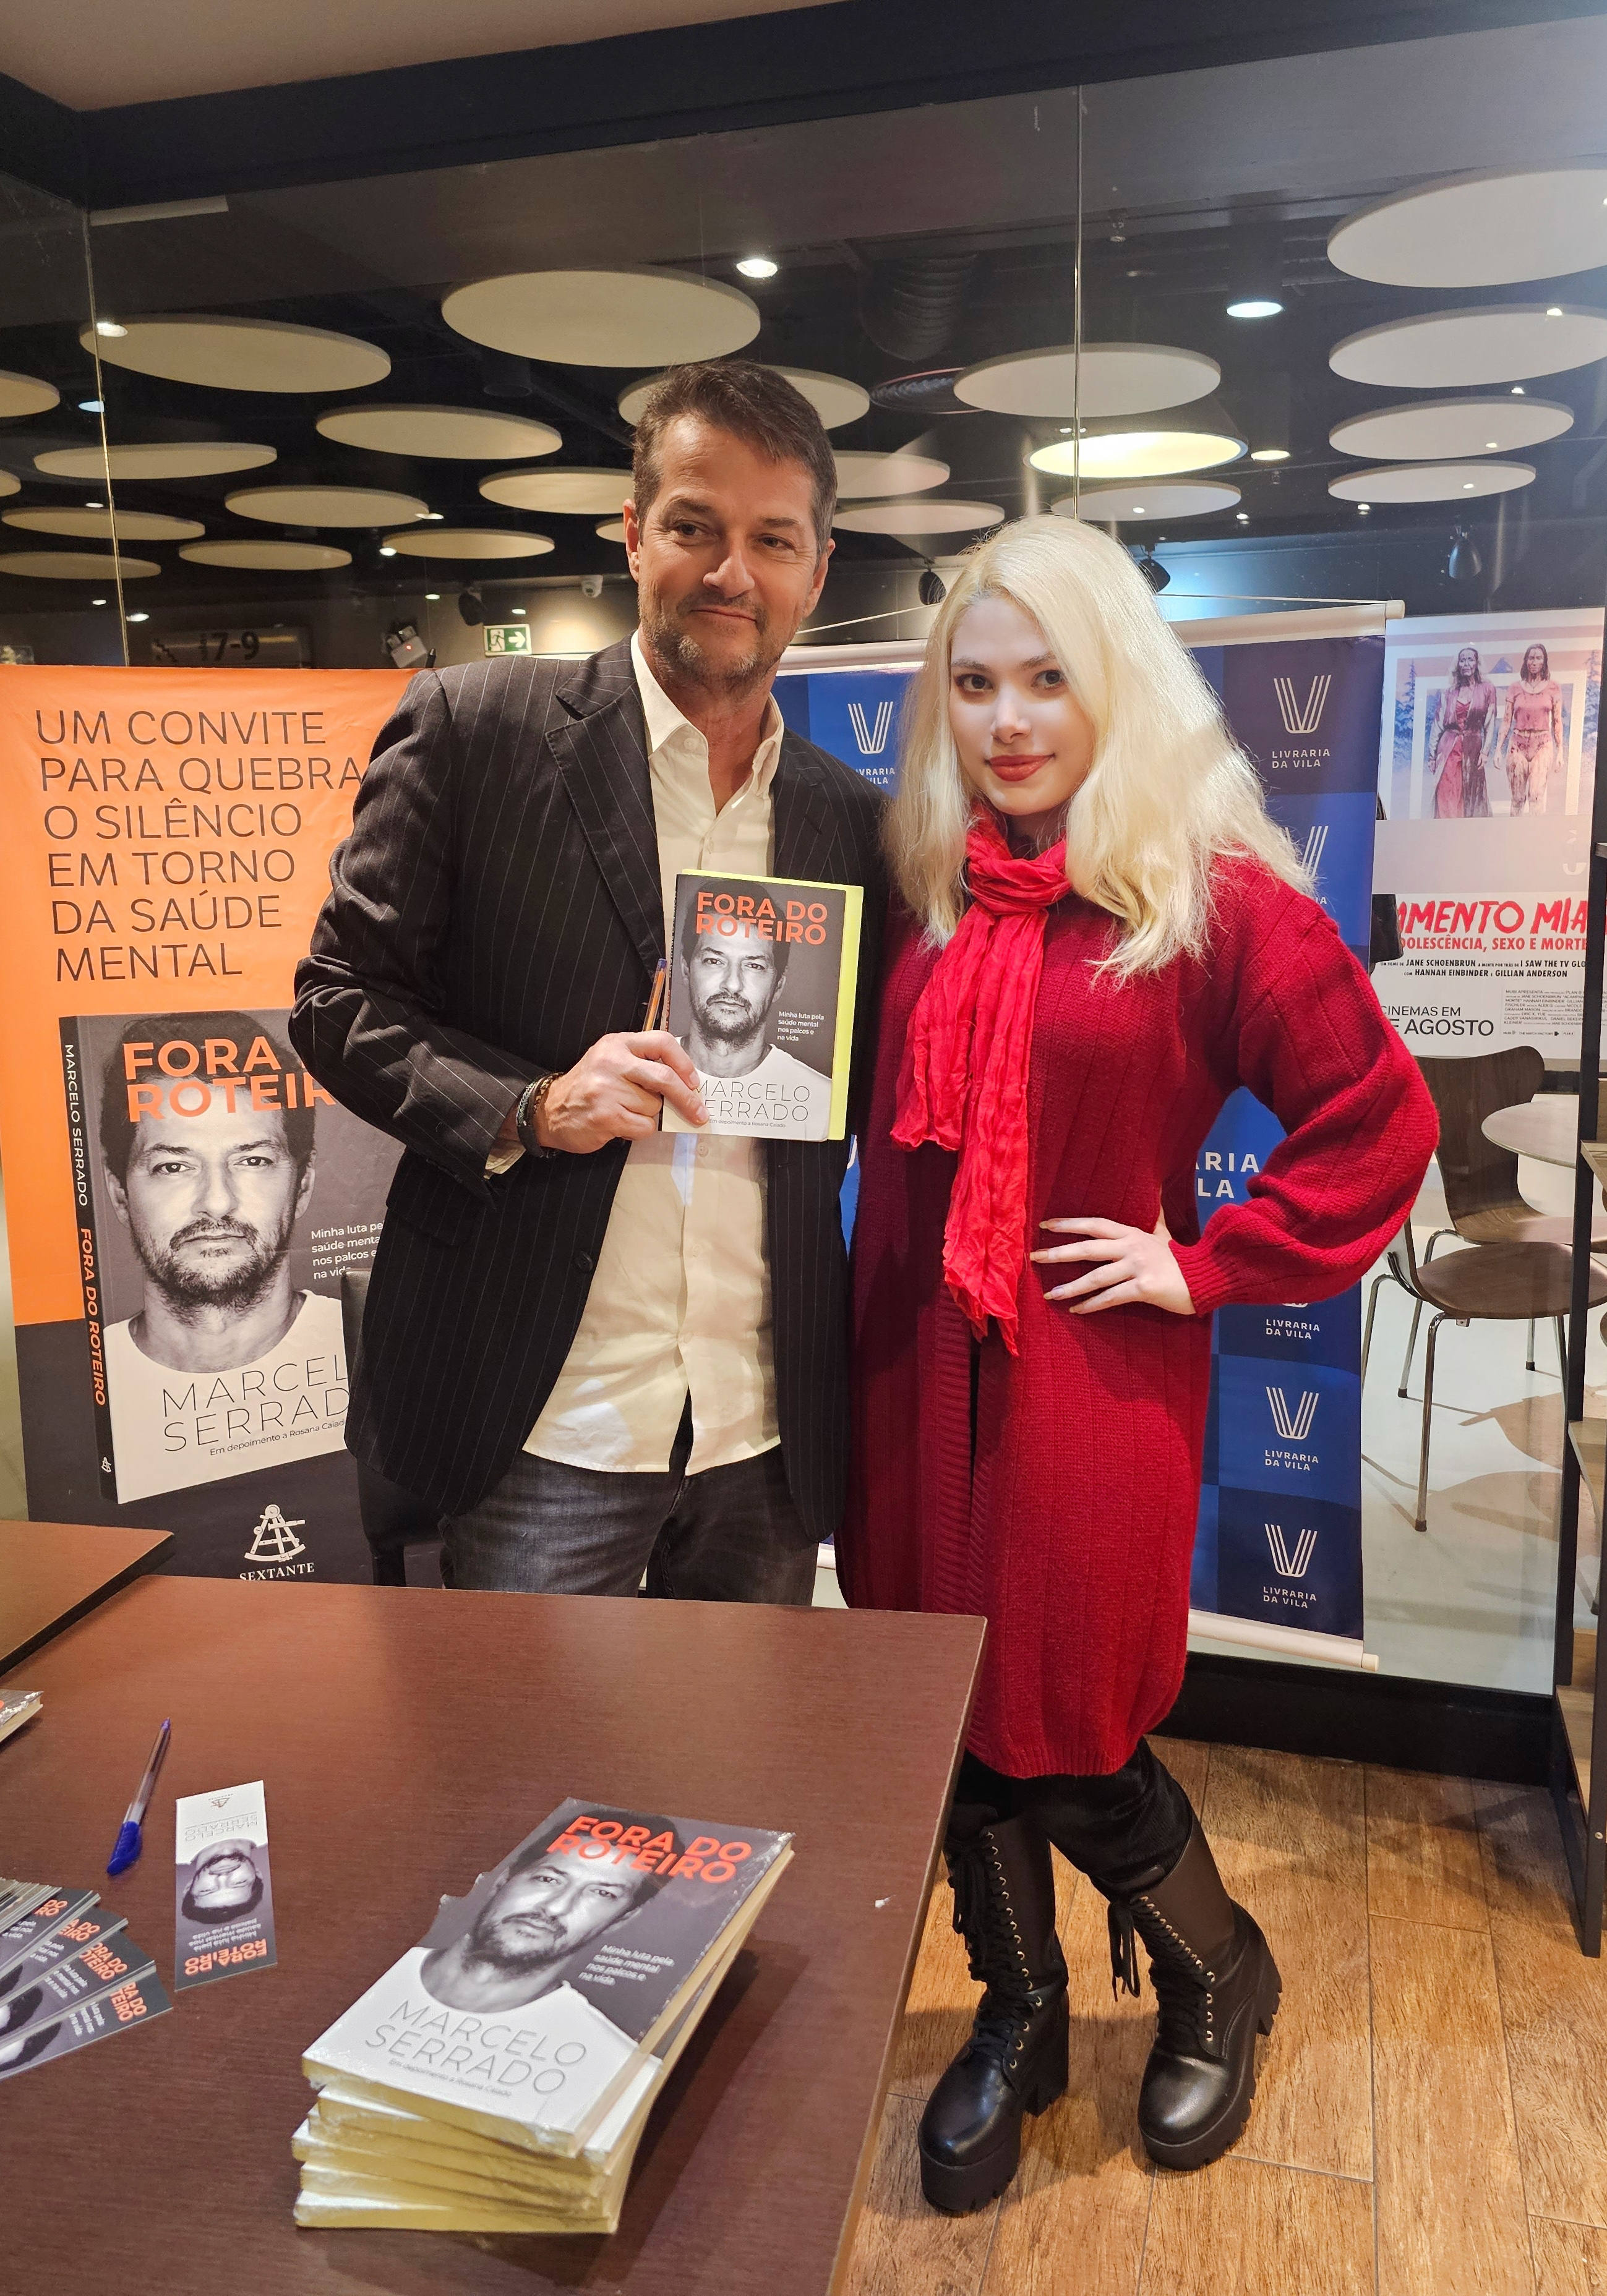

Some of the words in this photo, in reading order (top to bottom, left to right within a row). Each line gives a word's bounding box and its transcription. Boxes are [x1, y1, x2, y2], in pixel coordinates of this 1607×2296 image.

[36, 709, 111, 745] UM
[127, 711, 326, 745] CONVITE
[1272, 748, 1331, 759] LIVRARIA
[1272, 760, 1287, 769] DA
[1293, 759, 1321, 768] VILA
[41, 758, 164, 792] PARA
[179, 757, 362, 795] QUEBRA
[44, 805, 78, 840] O
[95, 797, 301, 840] SILÊNCIO
[48, 853, 118, 887] EM
[132, 848, 295, 886] TORNO
[52, 899, 116, 934] DA
[131, 889, 282, 932] SAÚDE
[697, 892, 776, 919] FORA
[786, 900, 828, 923] DO
[1530, 897, 1588, 934] MIA
[696, 913, 826, 945] ROTEIRO
[1492, 937, 1525, 950] SEXO
[1530, 937, 1536, 950] E
[1541, 937, 1587, 950] MORTE
[56, 942, 242, 982] MENTAL
[1426, 959, 1476, 967] SCHOENBRUN
[1380, 1005, 1438, 1016] CINEMAS
[1441, 1007, 1461, 1016] EM
[1404, 1018, 1494, 1036] AGOSTO
[124, 1036, 281, 1080] FORA
[65, 1044, 80, 1123] MARCELO
[127, 1072, 336, 1122] ROTEIR
[705, 1099, 808, 1122] ERRADO
[72, 1127, 88, 1206] SERRADO
[1198, 1177, 1235, 1198] LA
[311, 1227, 345, 1239] Minha
[347, 1224, 367, 1234] luta
[370, 1219, 385, 1233] pe
[80, 1228, 95, 1280] FORA
[311, 1240, 345, 1253] saúde
[347, 1235, 380, 1248] menta
[312, 1256, 333, 1266] nos
[335, 1251, 369, 1265] palcos
[314, 1270, 327, 1279] na
[329, 1265, 351, 1277] vid
[85, 1286, 98, 1317] DO
[1266, 1318, 1320, 1331] LIVRARIA
[1266, 1328, 1281, 1336] DA
[1285, 1329, 1311, 1339] VILA
[87, 1320, 106, 1406] ROTEIRO
[163, 1354, 348, 1417] MARCEL
[164, 1388, 350, 1452] SERRAD
[210, 1446, 225, 1456] Em
[227, 1435, 280, 1451] depoimento
[289, 1426, 320, 1437] Rosana
[322, 1419, 346, 1430] Caiad
[1265, 1449, 1319, 1464] LIVRARIA
[1265, 1458, 1280, 1467] DA
[1284, 1460, 1311, 1471] VILA
[239, 1562, 315, 1581] SEXTANTE
[1263, 1586, 1317, 1602] LIVRARIA
[1263, 1595, 1278, 1603] DA
[1282, 1597, 1308, 1608] VILA
[565, 1816, 674, 1853] FORA
[685, 1837, 752, 1863] DO
[546, 1833, 737, 1883] ROTEIRO
[44, 1900, 68, 1908] DO
[78, 1921, 100, 1934] DO
[185, 1939, 267, 1967] ROTEIRO
[218, 1946, 267, 1967] FORA
[601, 1944, 632, 1958] Minha
[632, 1950, 653, 1961] luta
[650, 1955, 675, 1967] pela
[107, 1957, 127, 1974] DO
[185, 1961, 212, 1976] DO
[585, 1963, 606, 1973] nos
[622, 1960, 662, 1974] mental
[578, 1971, 594, 1982] na
[593, 1974, 616, 1986] vida
[129, 1997, 147, 2016] DO
[389, 1999, 586, 2066] MARCELO
[366, 2025, 565, 2094] SERRADO
